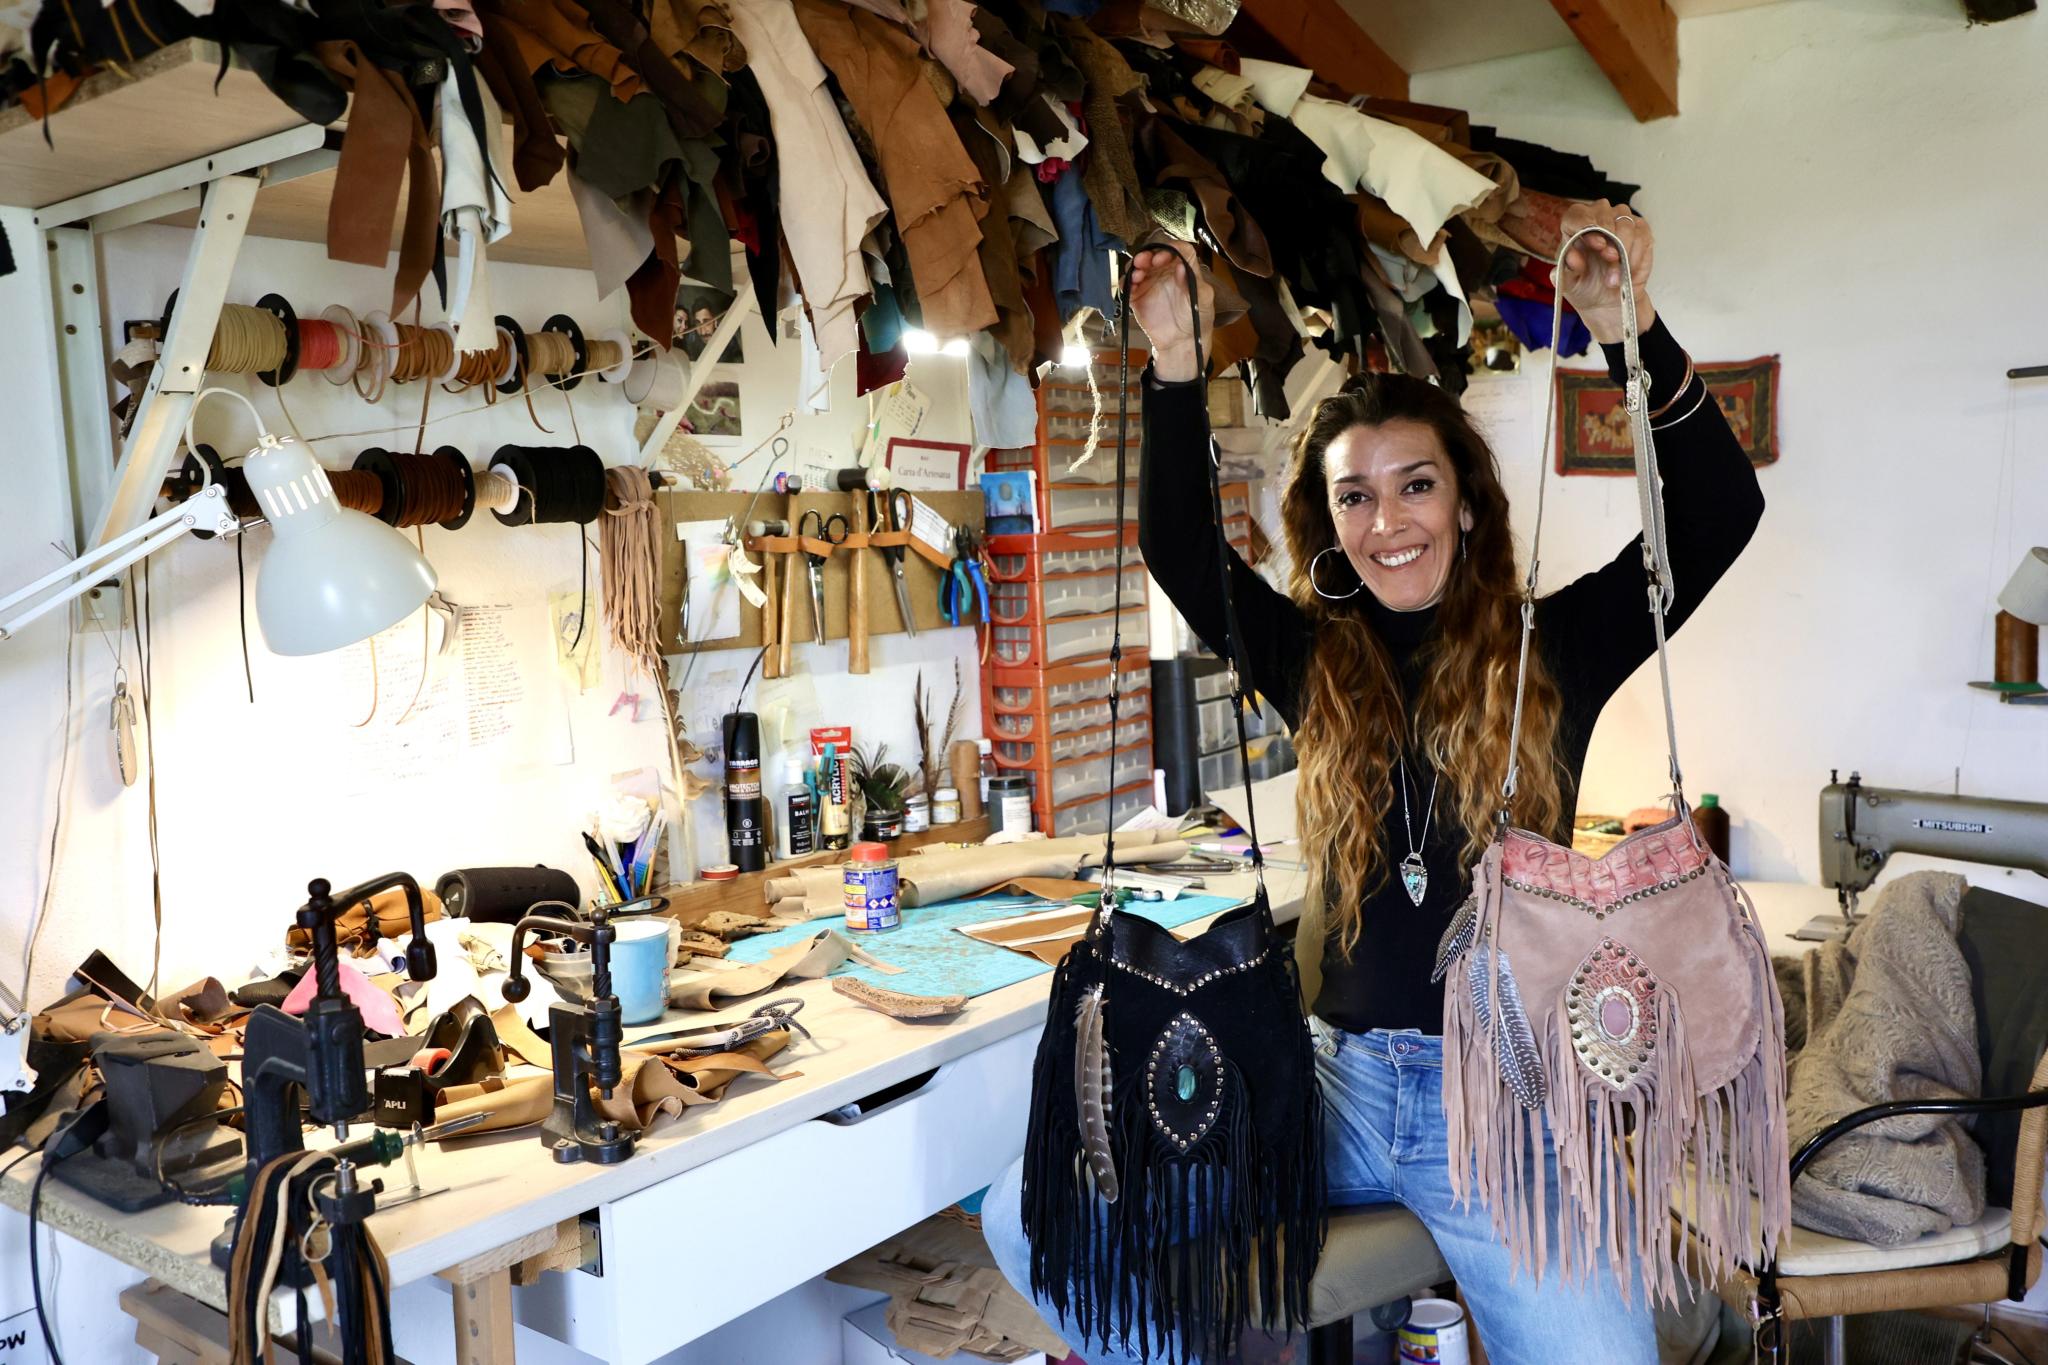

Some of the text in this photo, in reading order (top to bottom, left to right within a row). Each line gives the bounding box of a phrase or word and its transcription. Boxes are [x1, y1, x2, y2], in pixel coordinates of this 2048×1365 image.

[898, 466, 916, 477] Carta
[1923, 820, 1983, 833] MITSUBISHI
[385, 1100, 406, 1110] APLI
